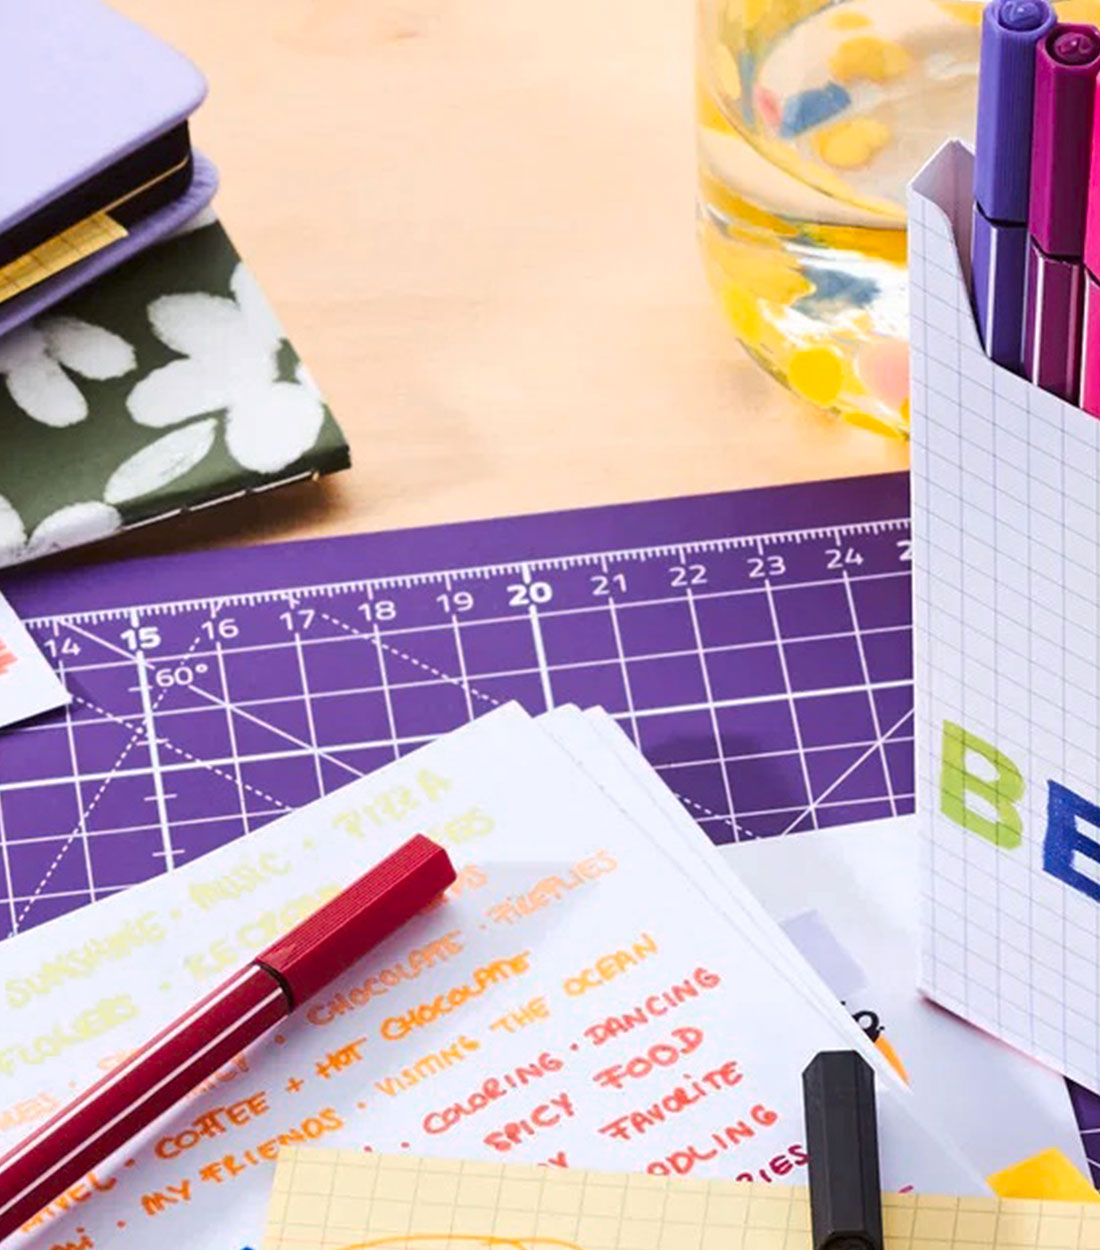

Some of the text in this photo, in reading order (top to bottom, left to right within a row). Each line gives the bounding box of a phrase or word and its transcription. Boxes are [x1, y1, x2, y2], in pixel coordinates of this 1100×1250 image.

[44, 637, 81, 658] 14
[120, 627, 161, 650] 15
[201, 619, 239, 641] 16
[279, 609, 316, 631] 17
[358, 601, 397, 622] 18
[436, 592, 475, 614] 19
[506, 581, 554, 606] 20
[590, 574, 627, 596] 21
[669, 565, 708, 587] 22
[748, 556, 787, 578] 23
[825, 549, 864, 569] 24
[306, 930, 464, 1026] CHOCOLATE
[315, 1037, 368, 1079] HOT
[380, 950, 532, 1042] CHOCOLATE
[140, 1180, 191, 1216] MY
[199, 1107, 344, 1183] FRIENDS
[491, 996, 551, 1034] THE
[563, 933, 658, 999] OCEAN
[422, 967, 721, 1135] COLORING DANCING
[484, 1026, 704, 1151] SPICY FOOD
[646, 1104, 779, 1176] ODLING
